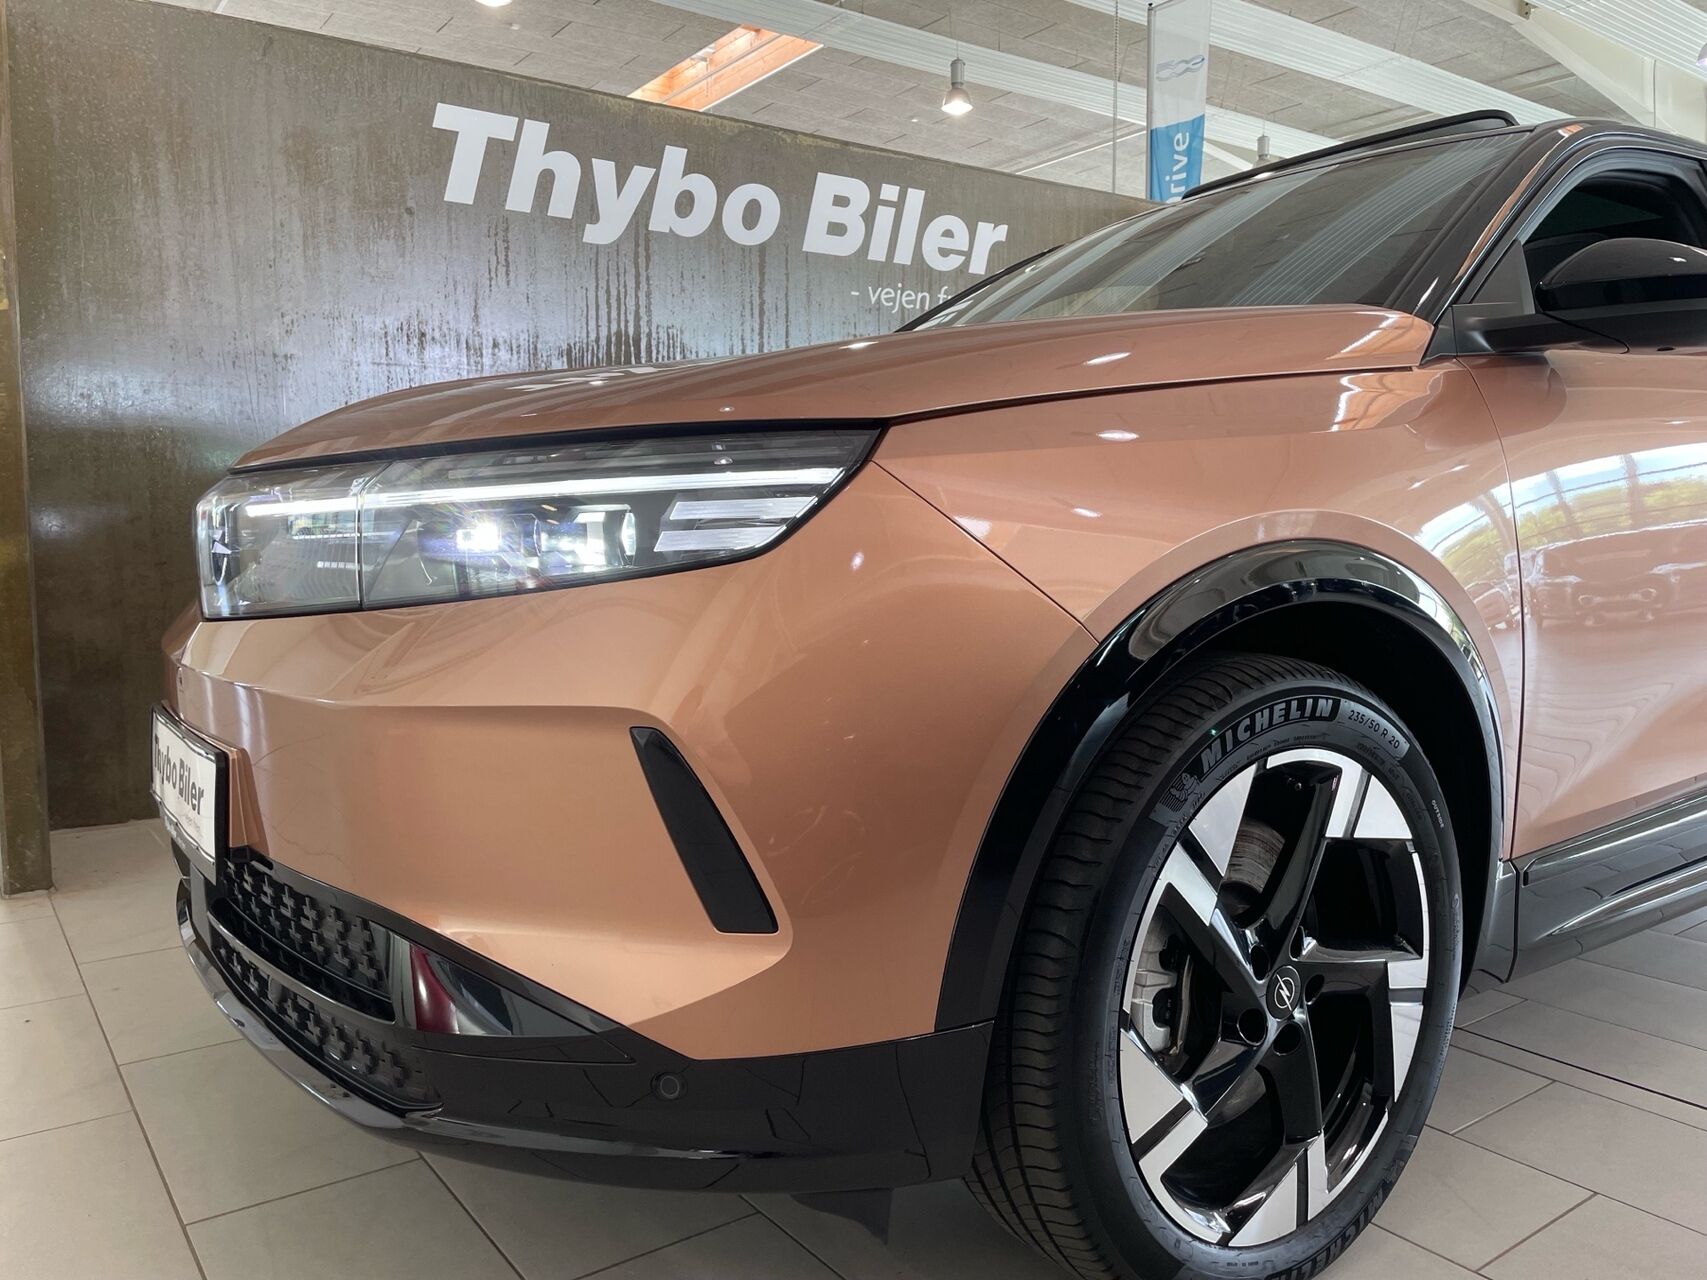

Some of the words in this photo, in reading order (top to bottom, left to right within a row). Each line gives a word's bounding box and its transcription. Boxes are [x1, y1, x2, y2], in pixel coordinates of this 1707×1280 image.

[432, 102, 781, 246] Thybo
[802, 171, 1008, 275] Biler
[868, 282, 930, 314] vejen
[1201, 698, 1333, 774] MICHELIN
[1348, 710, 1381, 734] 235/50
[1380, 727, 1389, 739] R
[1390, 735, 1401, 750] 20
[154, 733, 178, 790] Thybo
[179, 757, 205, 816] Biler
